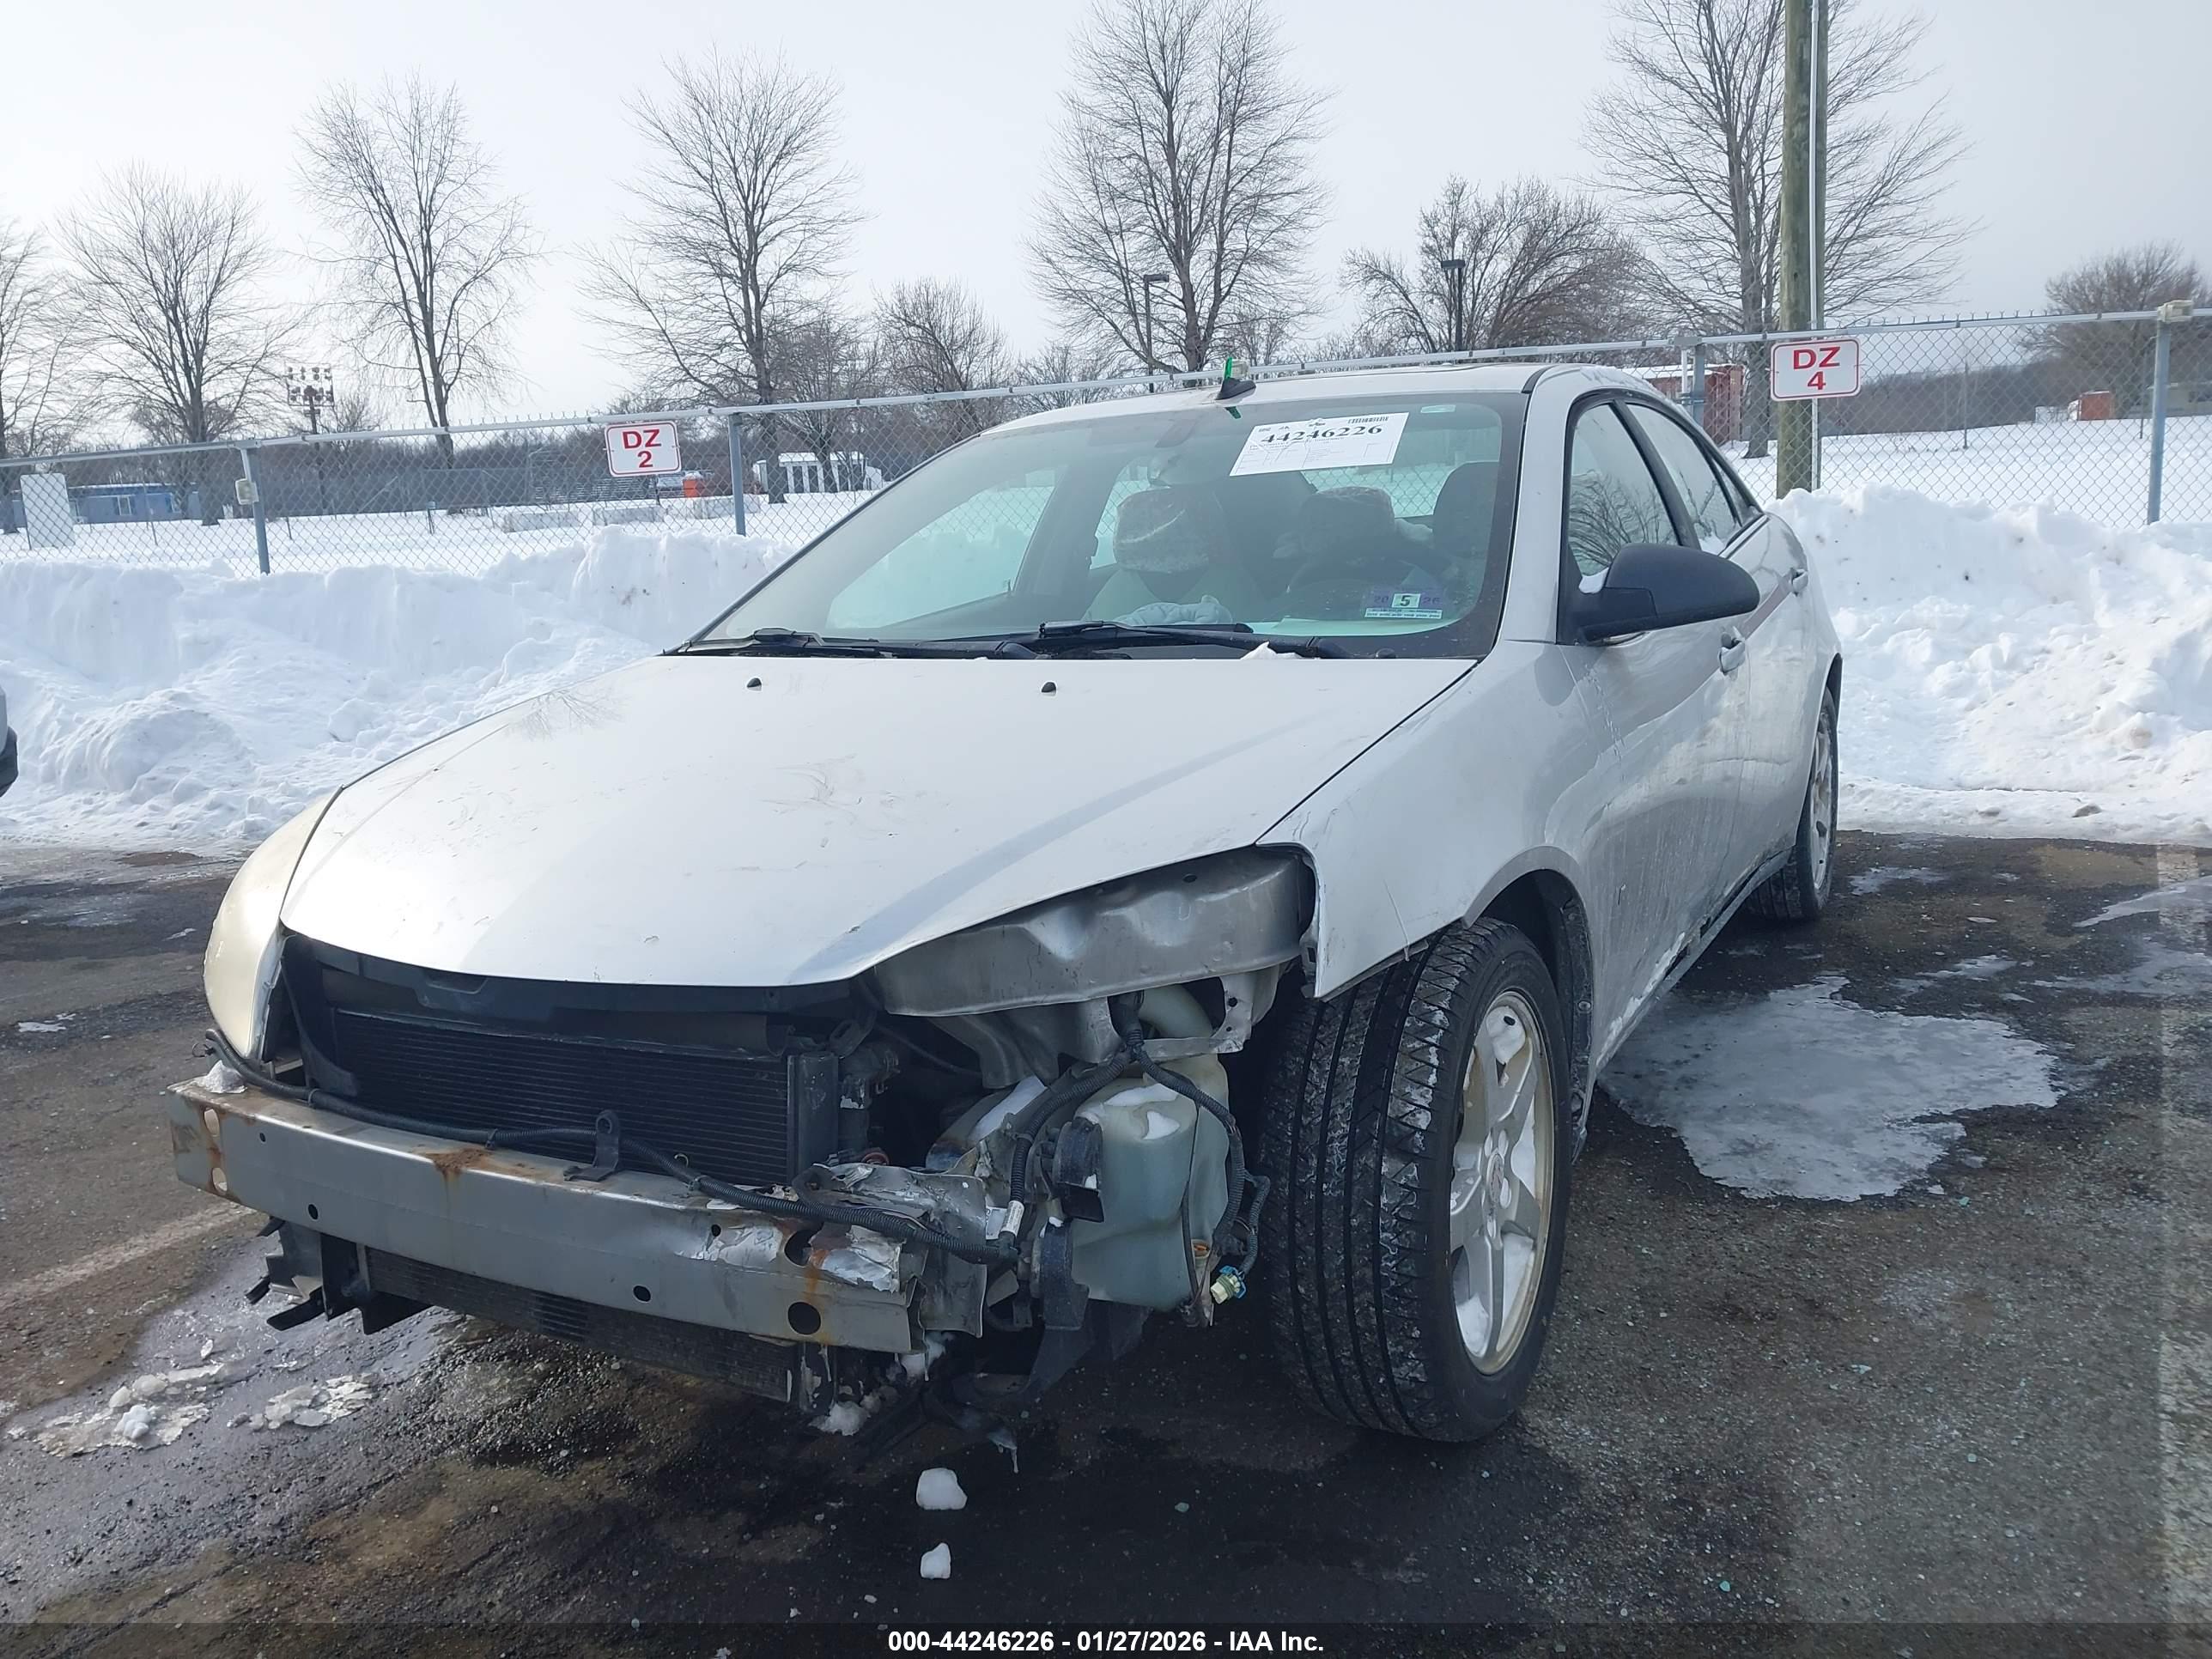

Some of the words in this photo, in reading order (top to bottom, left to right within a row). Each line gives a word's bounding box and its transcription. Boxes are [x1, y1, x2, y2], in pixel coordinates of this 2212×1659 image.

[1792, 346, 1841, 370] DZ
[1807, 371, 1826, 391] 4
[622, 428, 662, 449] DZ
[1261, 424, 1383, 443] 44246226
[637, 451, 653, 468] 2
[1400, 595, 1412, 606] 5
